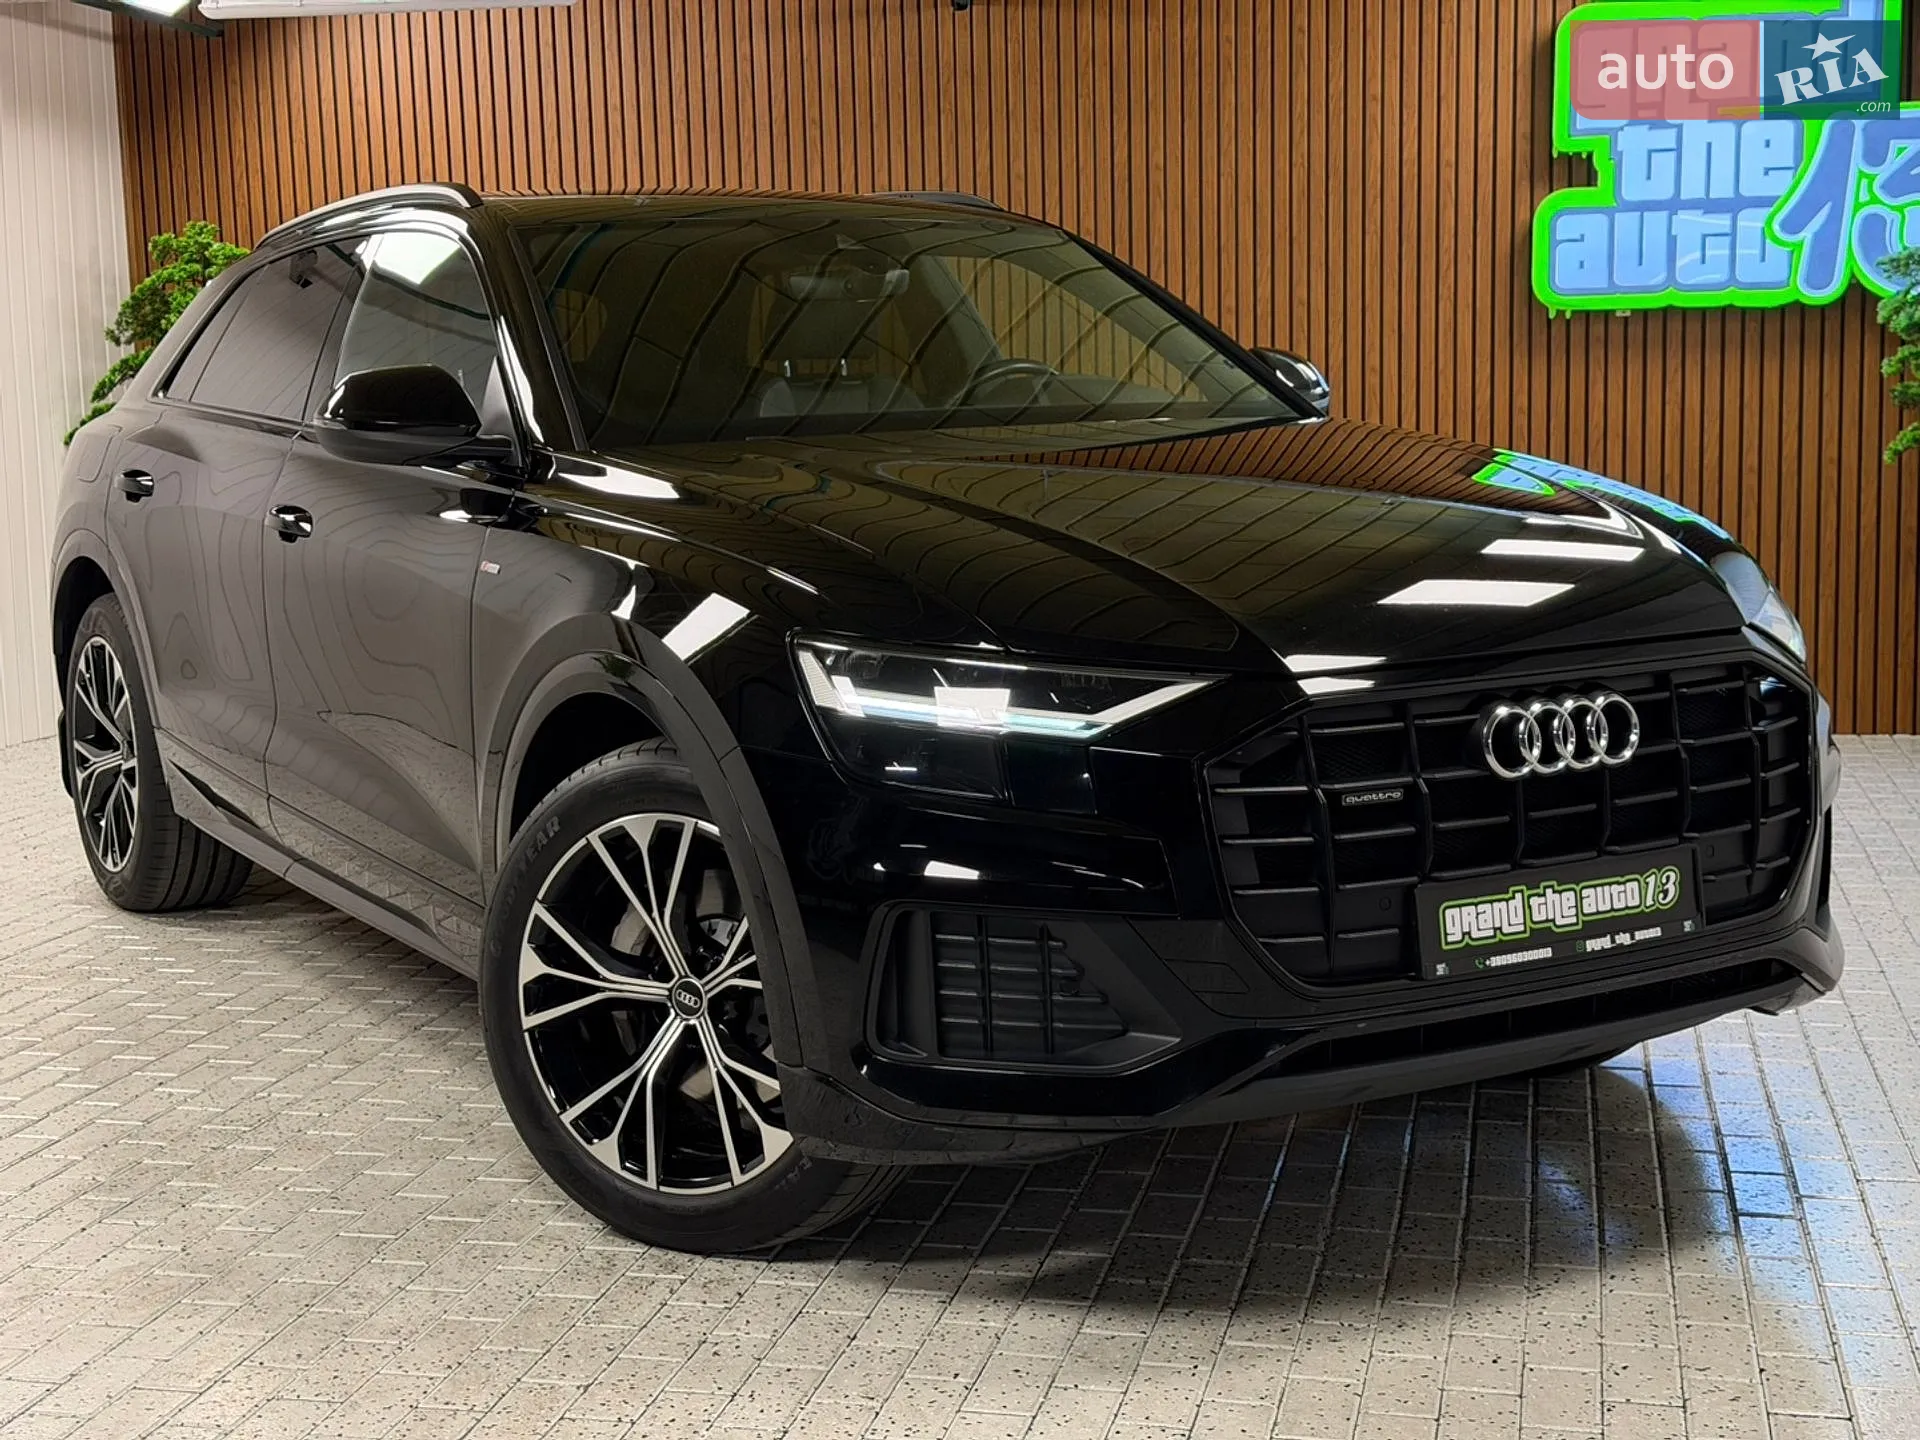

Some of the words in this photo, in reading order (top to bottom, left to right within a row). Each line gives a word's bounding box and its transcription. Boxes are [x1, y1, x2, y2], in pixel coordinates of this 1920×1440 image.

[1616, 117, 1796, 201] the
[1554, 206, 1792, 290] auto
[1345, 791, 1401, 805] quattro
[1445, 892, 1525, 943] grand
[1529, 887, 1577, 926] the
[1581, 880, 1641, 915] auto
[1645, 870, 1677, 908] 13
